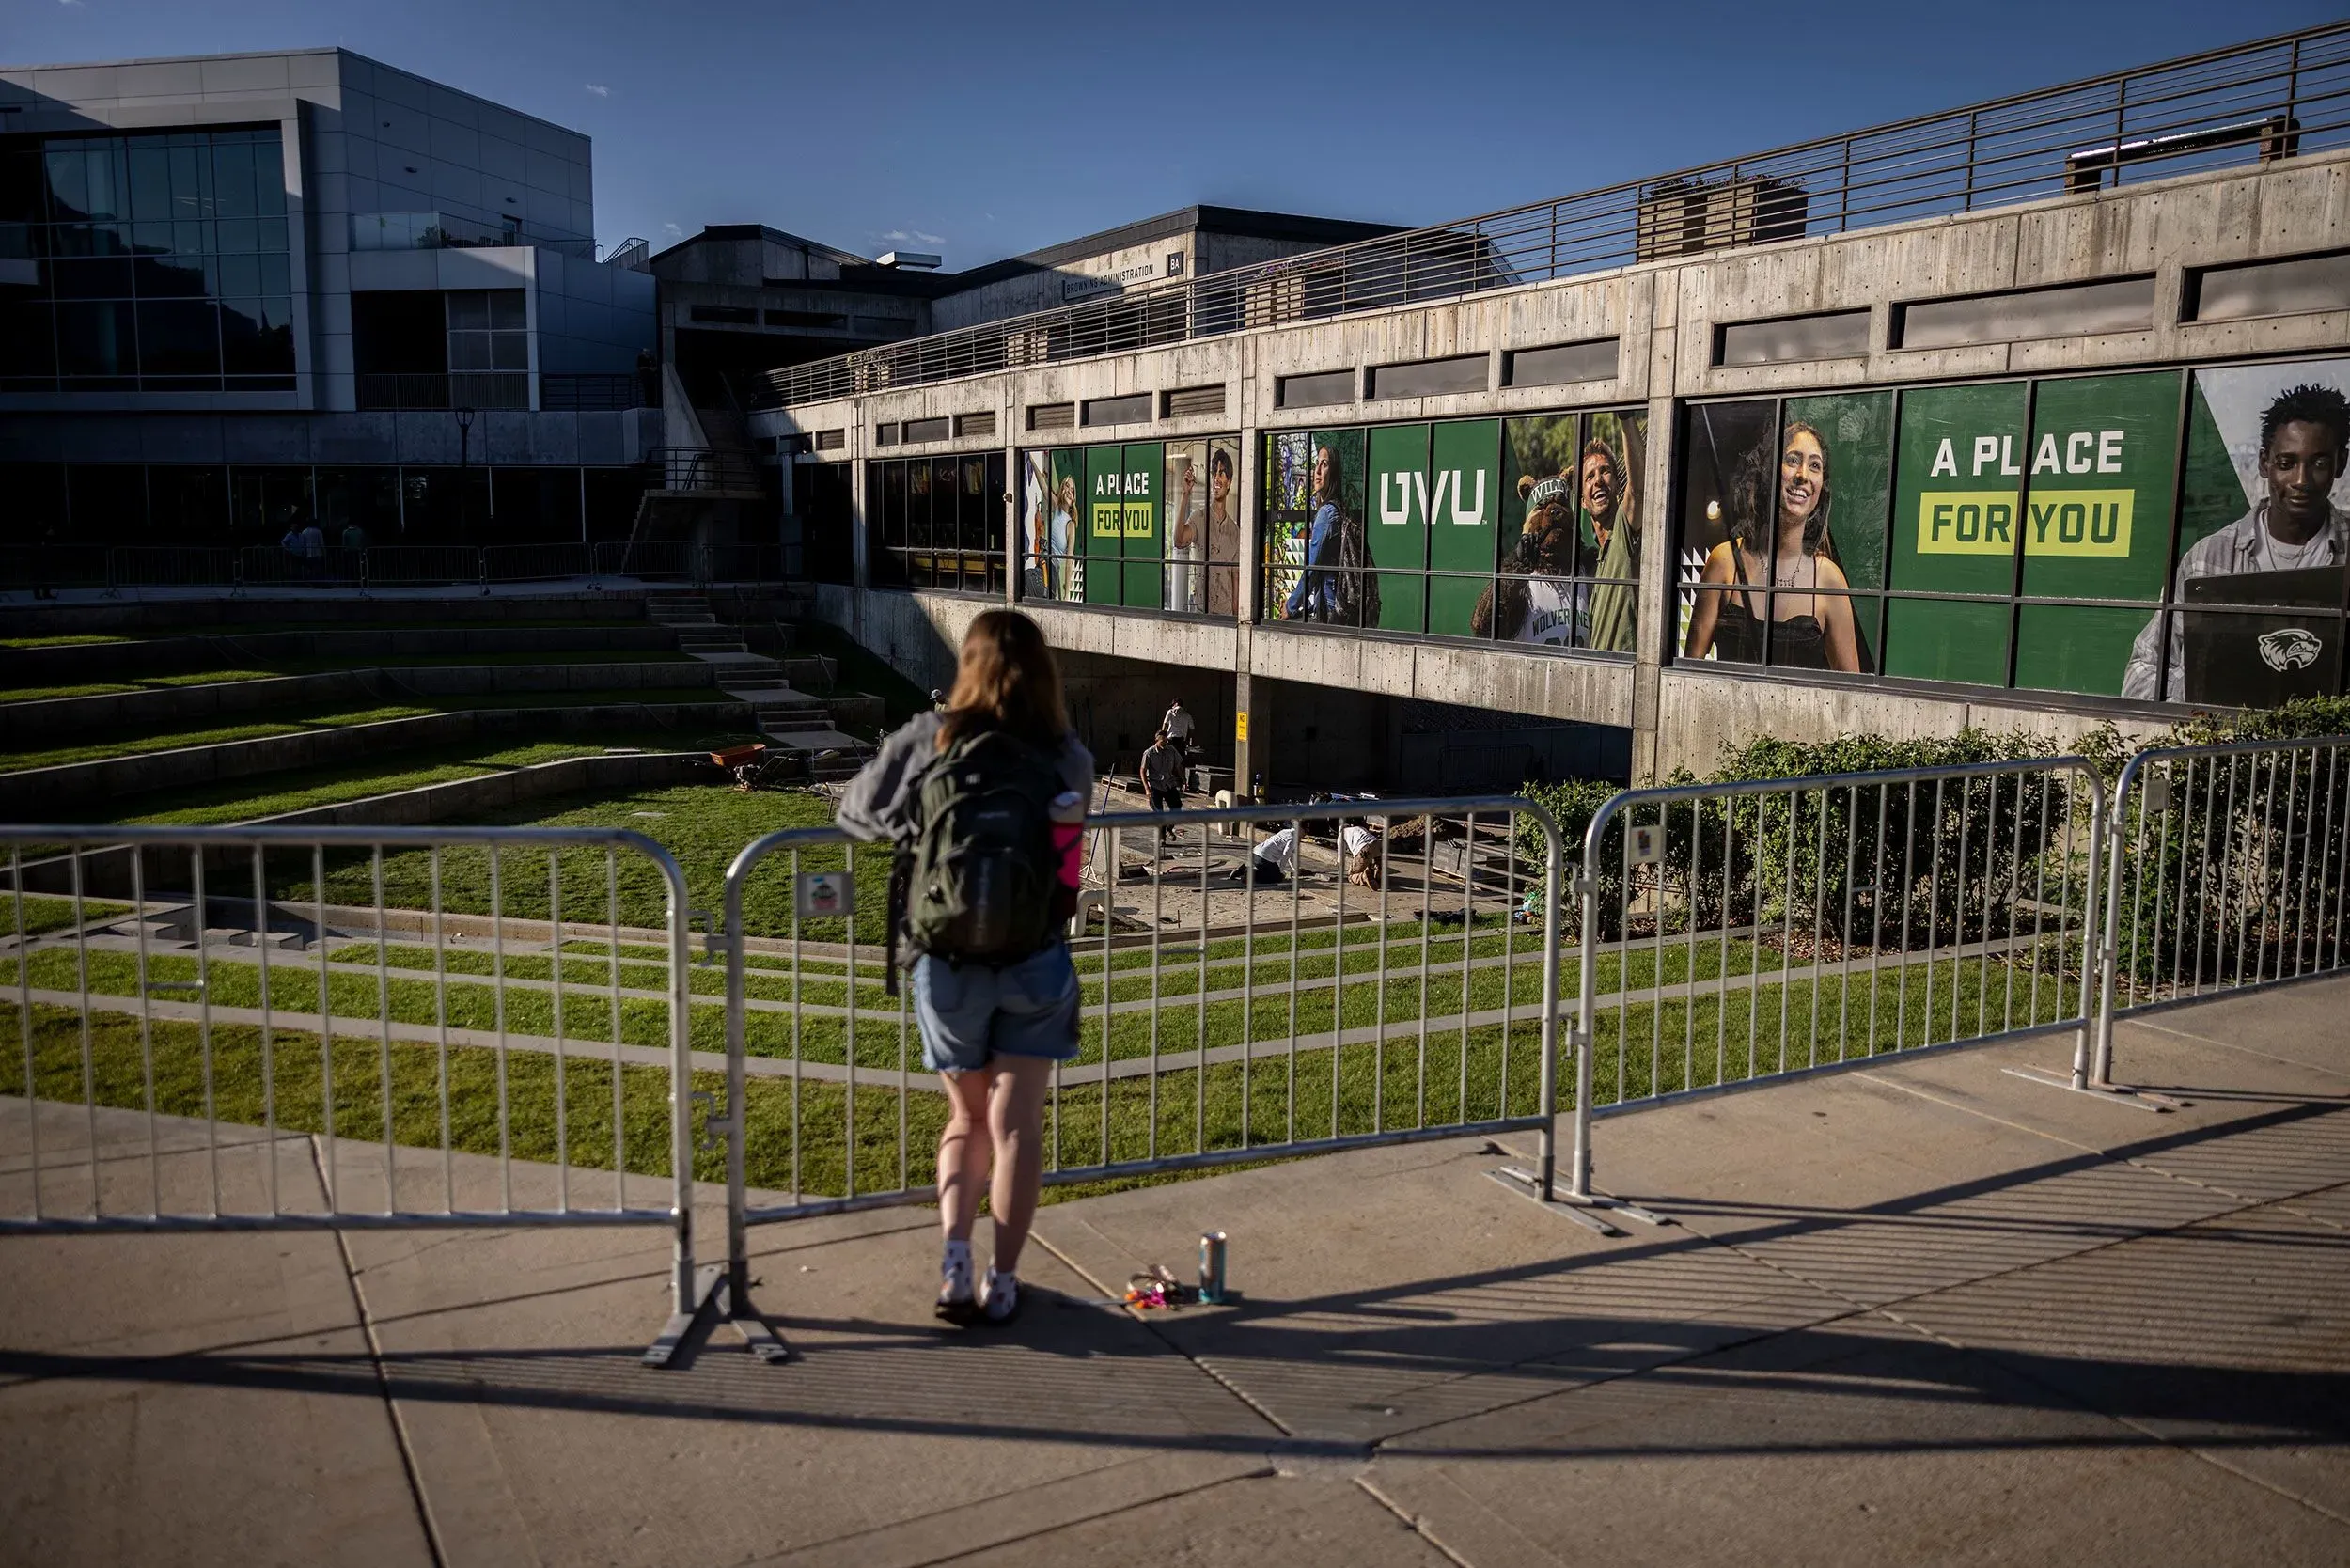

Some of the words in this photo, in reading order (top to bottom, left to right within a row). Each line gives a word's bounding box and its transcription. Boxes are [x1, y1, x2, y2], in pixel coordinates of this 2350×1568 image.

[1067, 278, 1098, 293] BROWNING
[1100, 264, 1153, 286] ADMINISTRATION
[1170, 258, 1180, 270] BA
[1930, 438, 1958, 477] A
[1972, 431, 2124, 476] PLACE
[1095, 474, 1104, 495] A
[1107, 472, 1149, 495] PLACE
[1380, 469, 1485, 525] UVU
[1097, 510, 1120, 530] FOR
[1124, 509, 1149, 530] YOU
[1931, 504, 2011, 542] FOR
[2030, 503, 2119, 543] YOU
